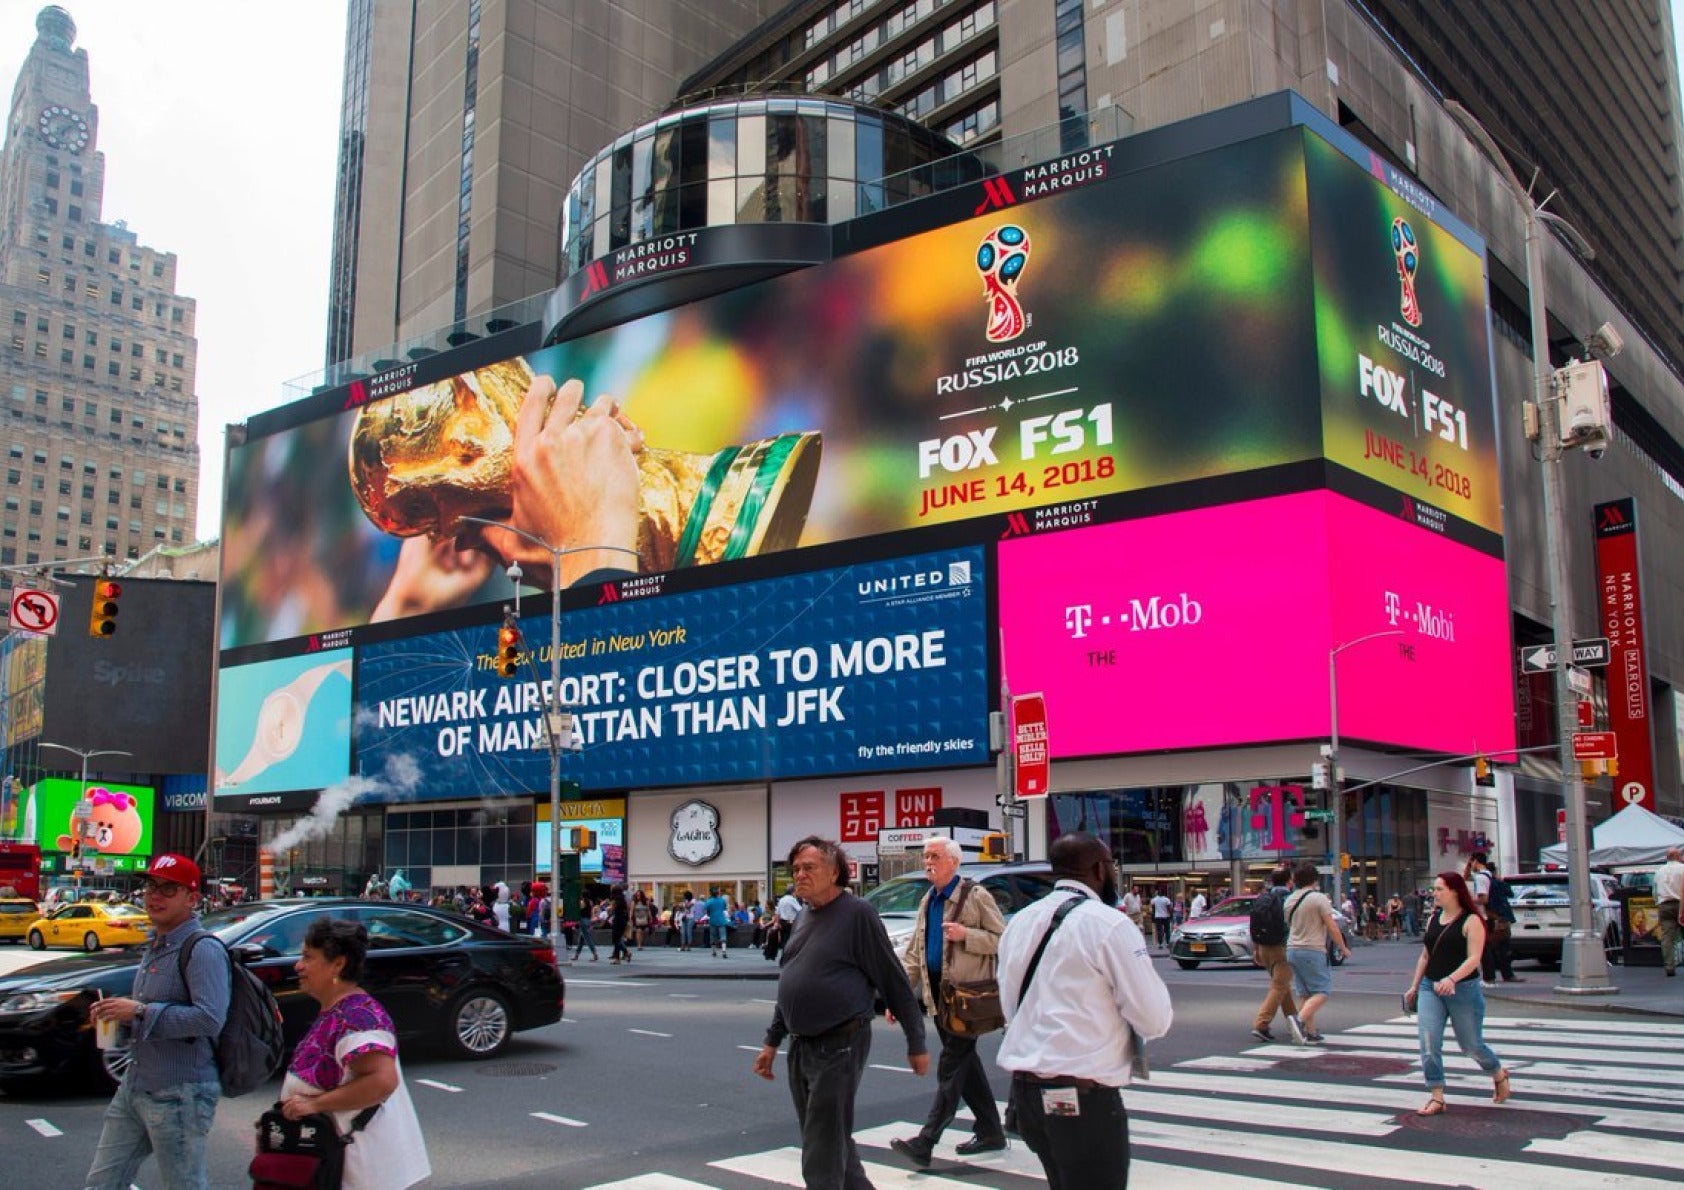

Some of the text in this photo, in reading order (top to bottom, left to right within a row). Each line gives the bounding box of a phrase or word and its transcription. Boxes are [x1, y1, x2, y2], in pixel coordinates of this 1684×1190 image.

[1024, 145, 1114, 182] MARRIOTT
[1024, 165, 1104, 197] MARQUIS
[1390, 170, 1435, 212] MARRIOTT
[616, 233, 698, 264] MARRIOTT
[616, 251, 687, 279] MARQUIS
[966, 341, 1047, 367] FIFA WORLD CUP
[1378, 324, 1420, 363] RUSSIA
[1421, 350, 1445, 378] 2018
[371, 364, 418, 385] MARRIOTT
[937, 347, 1079, 395] RUSSIA 2018
[371, 377, 413, 398] MARQUIS
[1359, 353, 1468, 451] FOX FS1
[919, 403, 1113, 479] FOX FS1
[1364, 428, 1472, 499] JUNE 14, 2018
[919, 456, 1115, 517] JUNE 14, 2018
[1035, 500, 1098, 519] MARRIOTT
[1035, 513, 1091, 530] MARQUIS
[1416, 502, 1447, 522] MARRIOTT
[1417, 514, 1444, 532] MARQUIS
[622, 575, 666, 589] MARRIOTT
[622, 585, 661, 598] MARQUIS
[859, 571, 943, 596] UNITED
[1605, 575, 1621, 647] NEW YORK
[322, 630, 353, 640] MARRIOTT
[1621, 572, 1642, 717] MARRIOTT MARQUIS
[476, 654, 499, 672] The
[591, 637, 605, 655] in
[609, 634, 644, 652] New
[649, 625, 687, 646] York
[1087, 650, 1116, 667] THE
[1398, 642, 1416, 661] THE
[1575, 646, 1600, 660] WAY
[378, 688, 487, 728] NEWARK
[637, 655, 760, 699] CLOSER
[769, 647, 818, 685] TO
[830, 629, 946, 679] MORE
[438, 726, 471, 757] OF
[671, 695, 766, 736] THAN
[777, 686, 845, 727] JFK
[858, 739, 974, 758] fly the friendly skies
[901, 794, 934, 813] UNI
[1629, 787, 1640, 800] P
